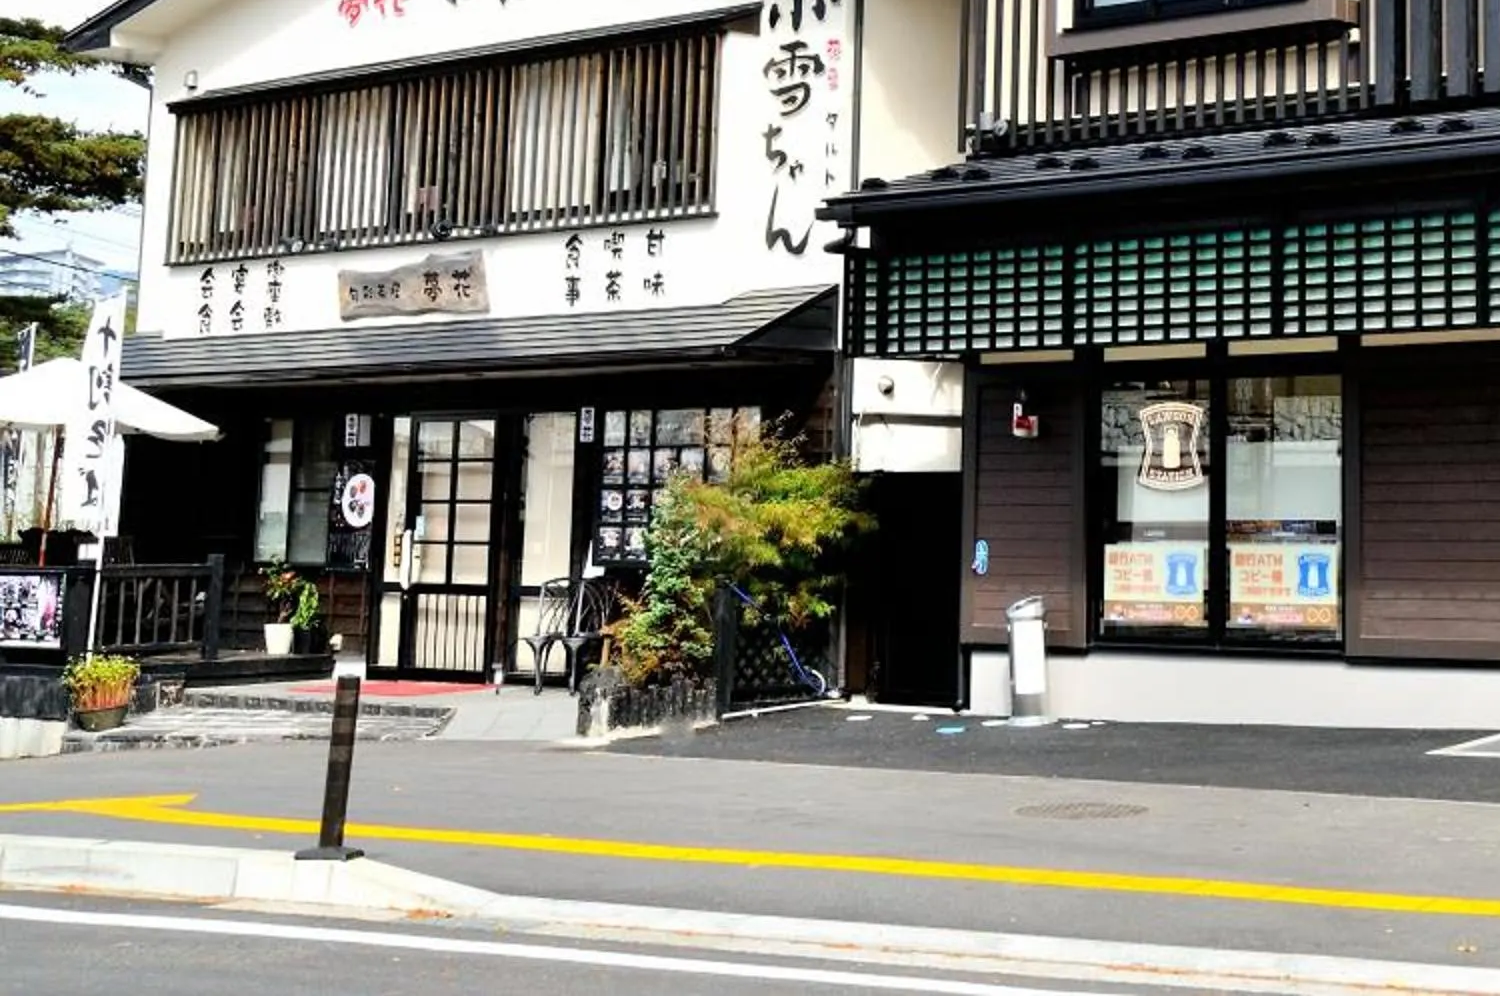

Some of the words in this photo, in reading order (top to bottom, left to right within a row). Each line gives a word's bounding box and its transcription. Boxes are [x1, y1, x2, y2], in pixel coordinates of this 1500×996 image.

[825, 112, 839, 186] タルト
[565, 233, 583, 307] 食事
[603, 230, 625, 302] 喫茶
[643, 228, 665, 296] 甘味
